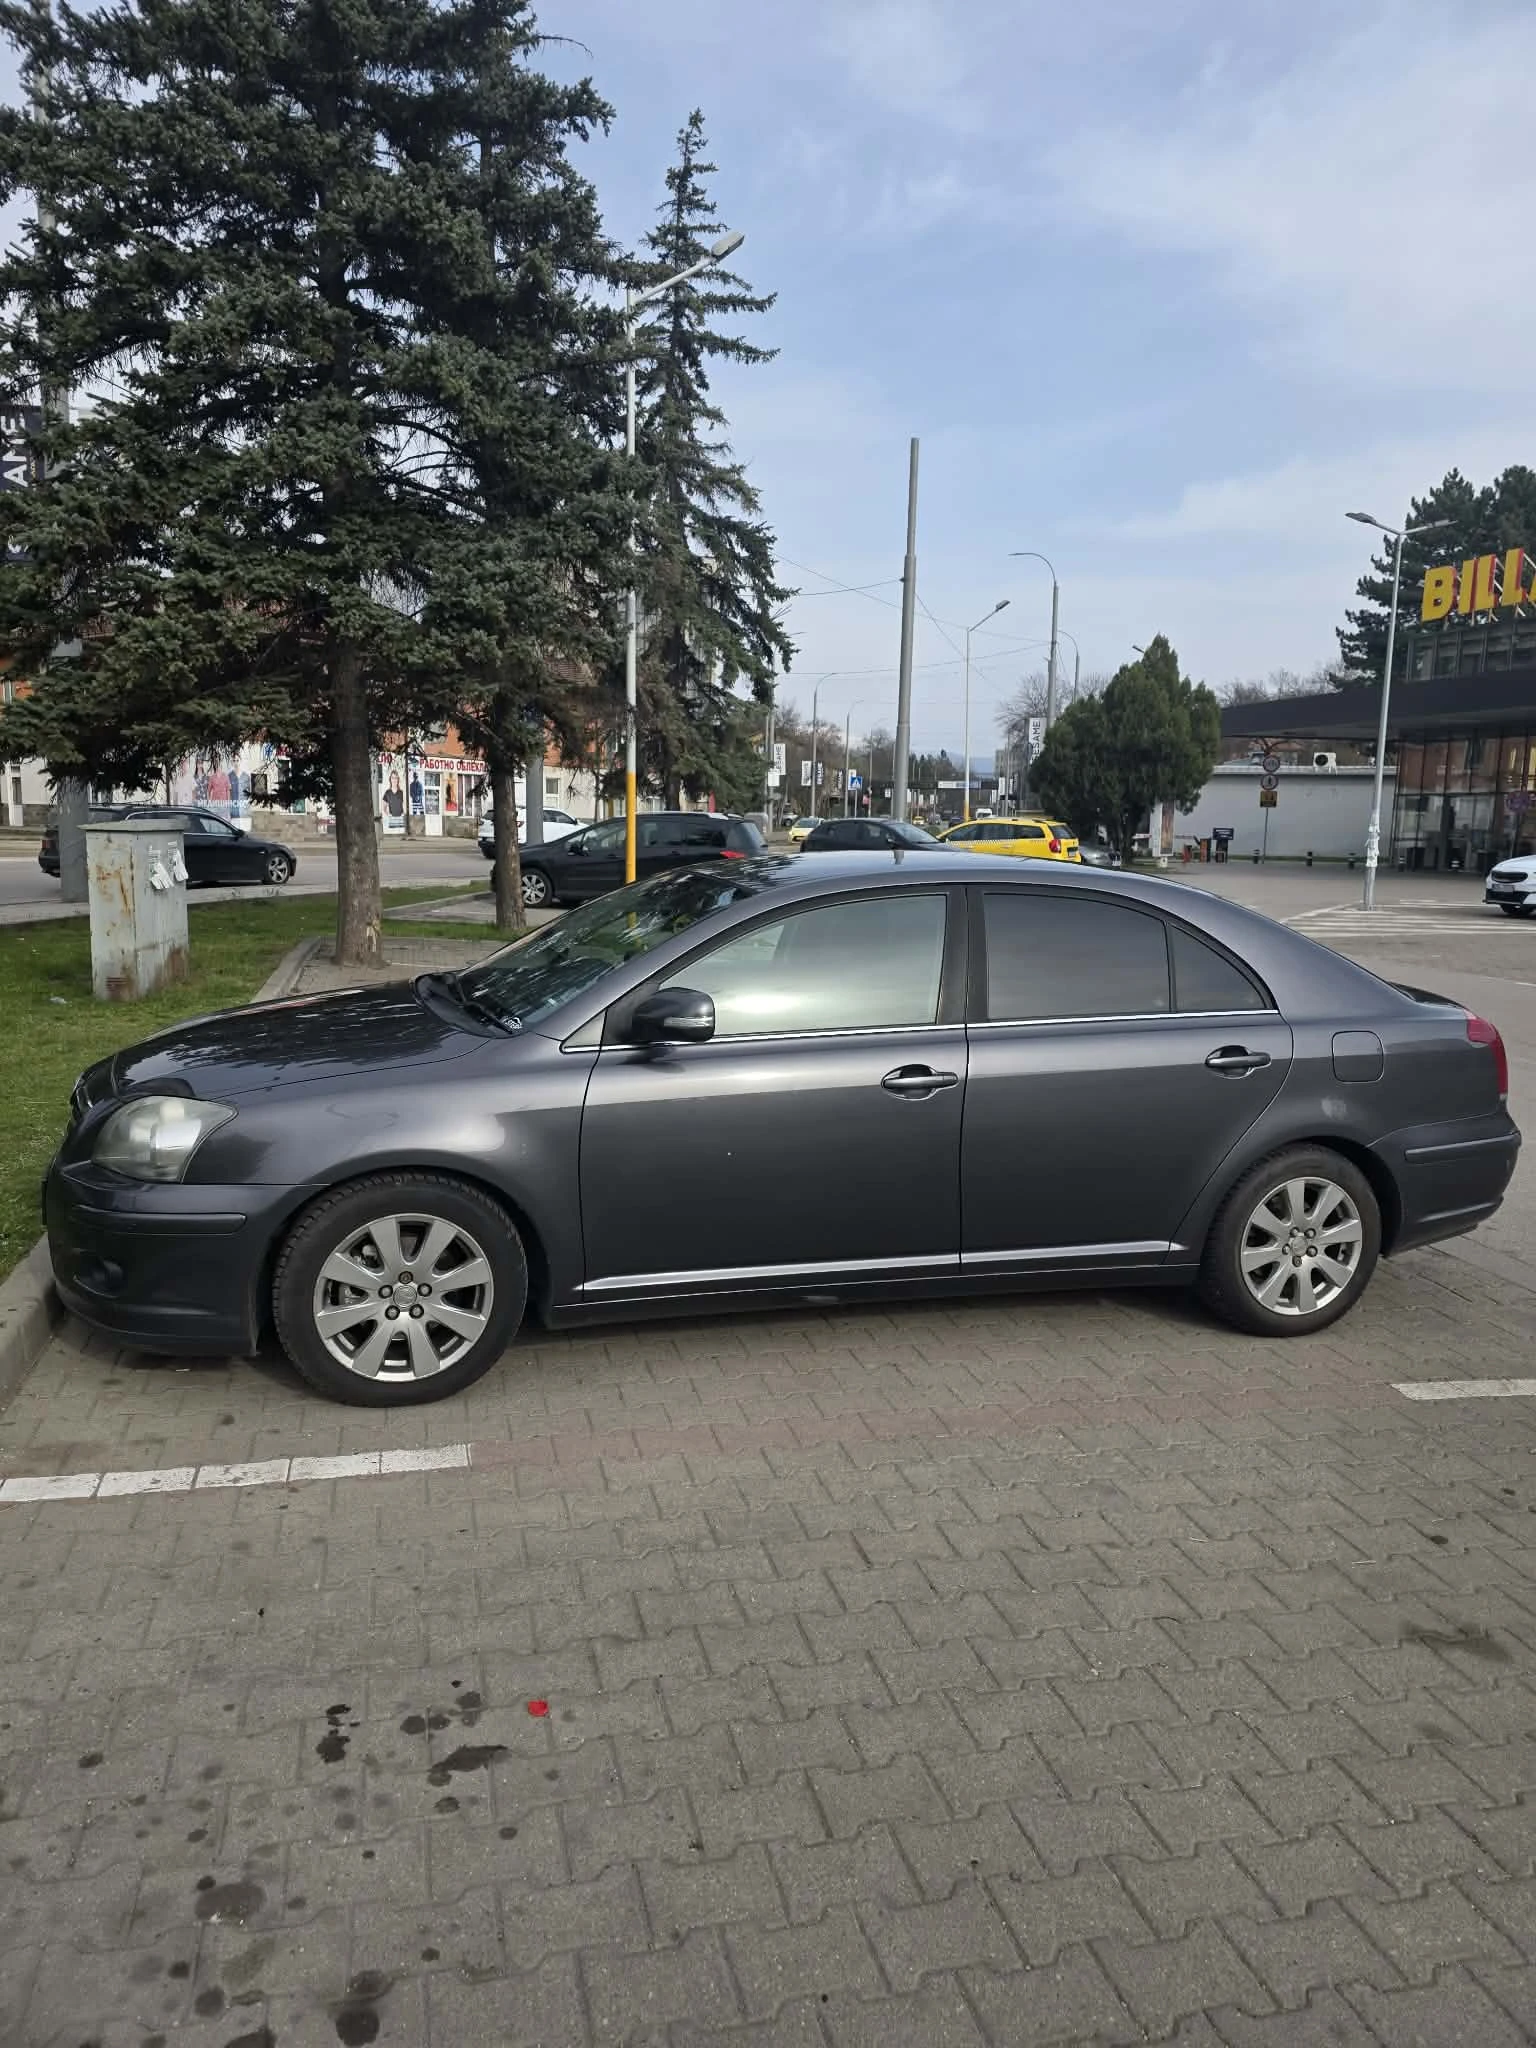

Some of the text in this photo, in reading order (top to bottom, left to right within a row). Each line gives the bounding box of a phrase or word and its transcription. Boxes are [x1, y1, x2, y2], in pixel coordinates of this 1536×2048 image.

[1421, 547, 1536, 621] BILL
[1032, 721, 1041, 759] ESAME
[420, 759, 454, 769] РАБОТНО
